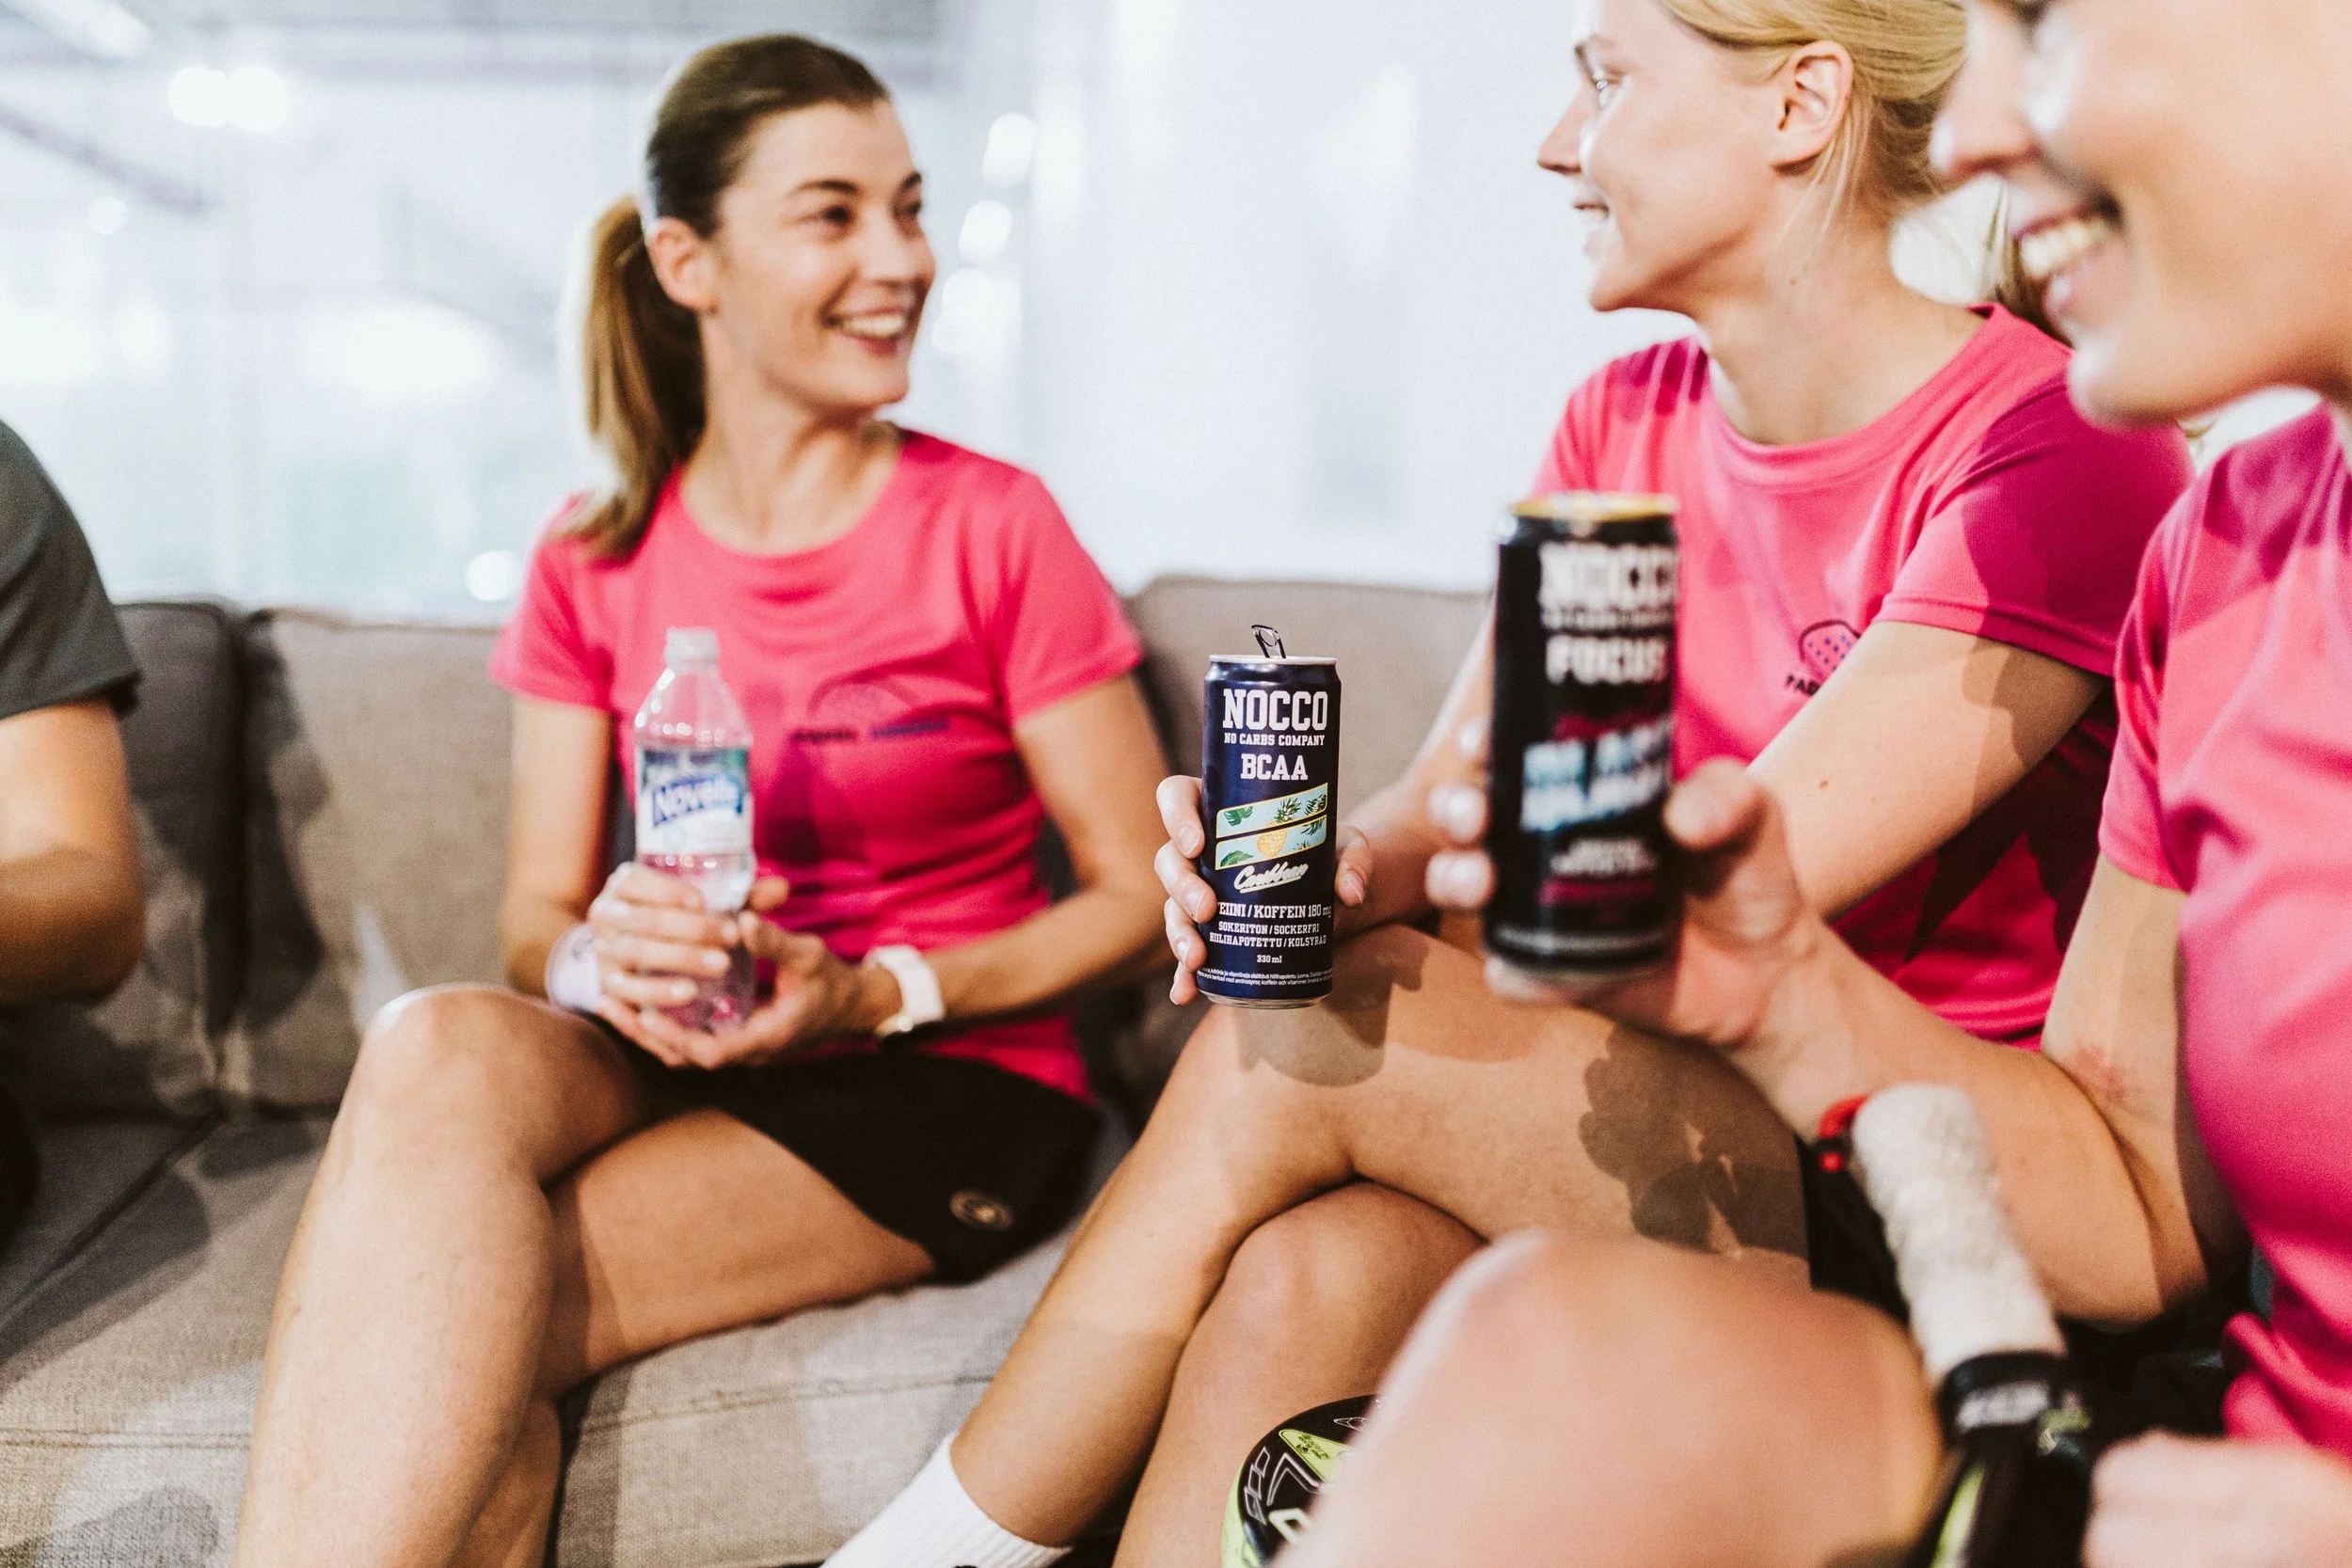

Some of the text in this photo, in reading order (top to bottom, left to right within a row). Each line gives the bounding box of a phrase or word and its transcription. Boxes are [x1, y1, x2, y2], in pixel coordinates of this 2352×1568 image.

[1223, 689, 1328, 731] NOCCO
[1224, 733, 1325, 746] NO CARBS COMPANY
[1240, 753, 1308, 781] BCAA
[1218, 902, 1247, 917] EIINI
[1308, 904, 1322, 917] 180
[1256, 955, 1282, 963] 330 ml
